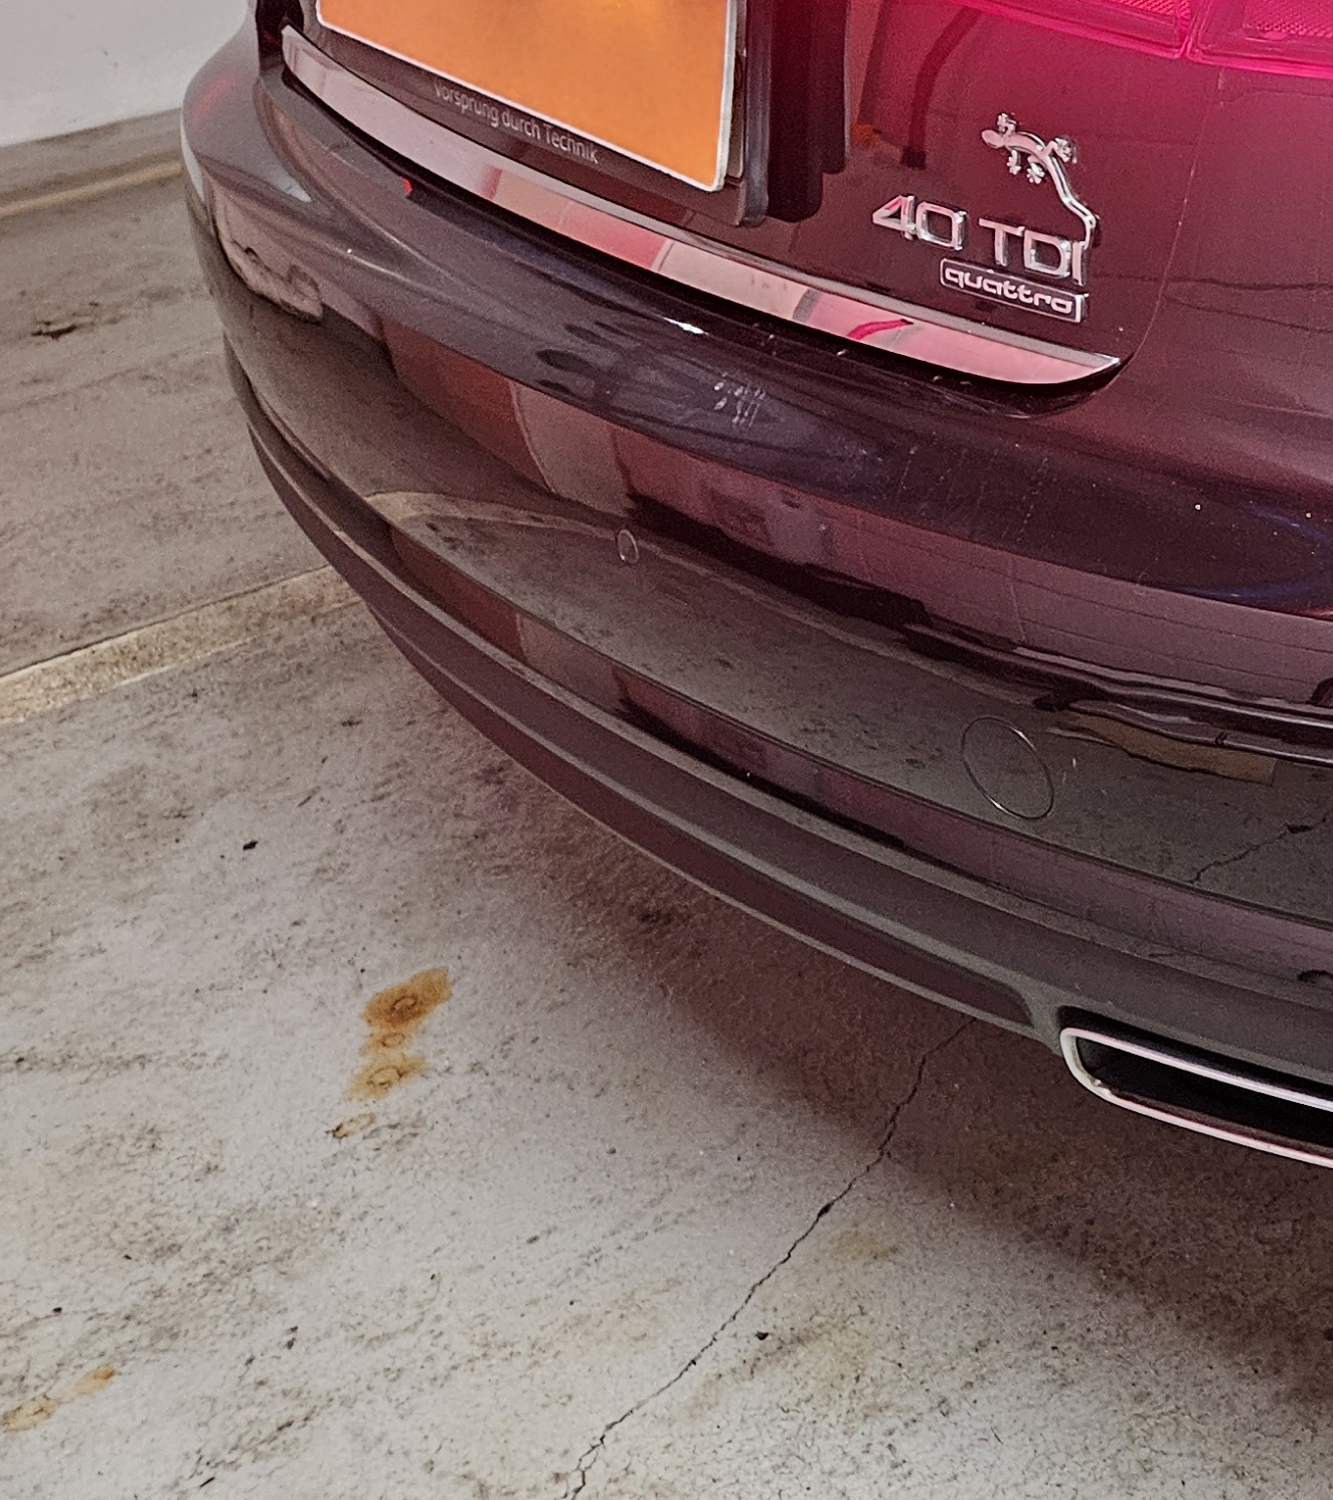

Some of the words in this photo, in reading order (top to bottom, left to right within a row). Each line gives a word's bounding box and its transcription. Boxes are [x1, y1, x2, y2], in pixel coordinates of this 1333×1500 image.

[433, 81, 499, 128] Vorsprung
[501, 109, 541, 140] durch
[543, 122, 599, 164] Technik
[872, 194, 967, 251] 40
[978, 216, 1088, 287] TDI
[943, 265, 1075, 315] quattro
